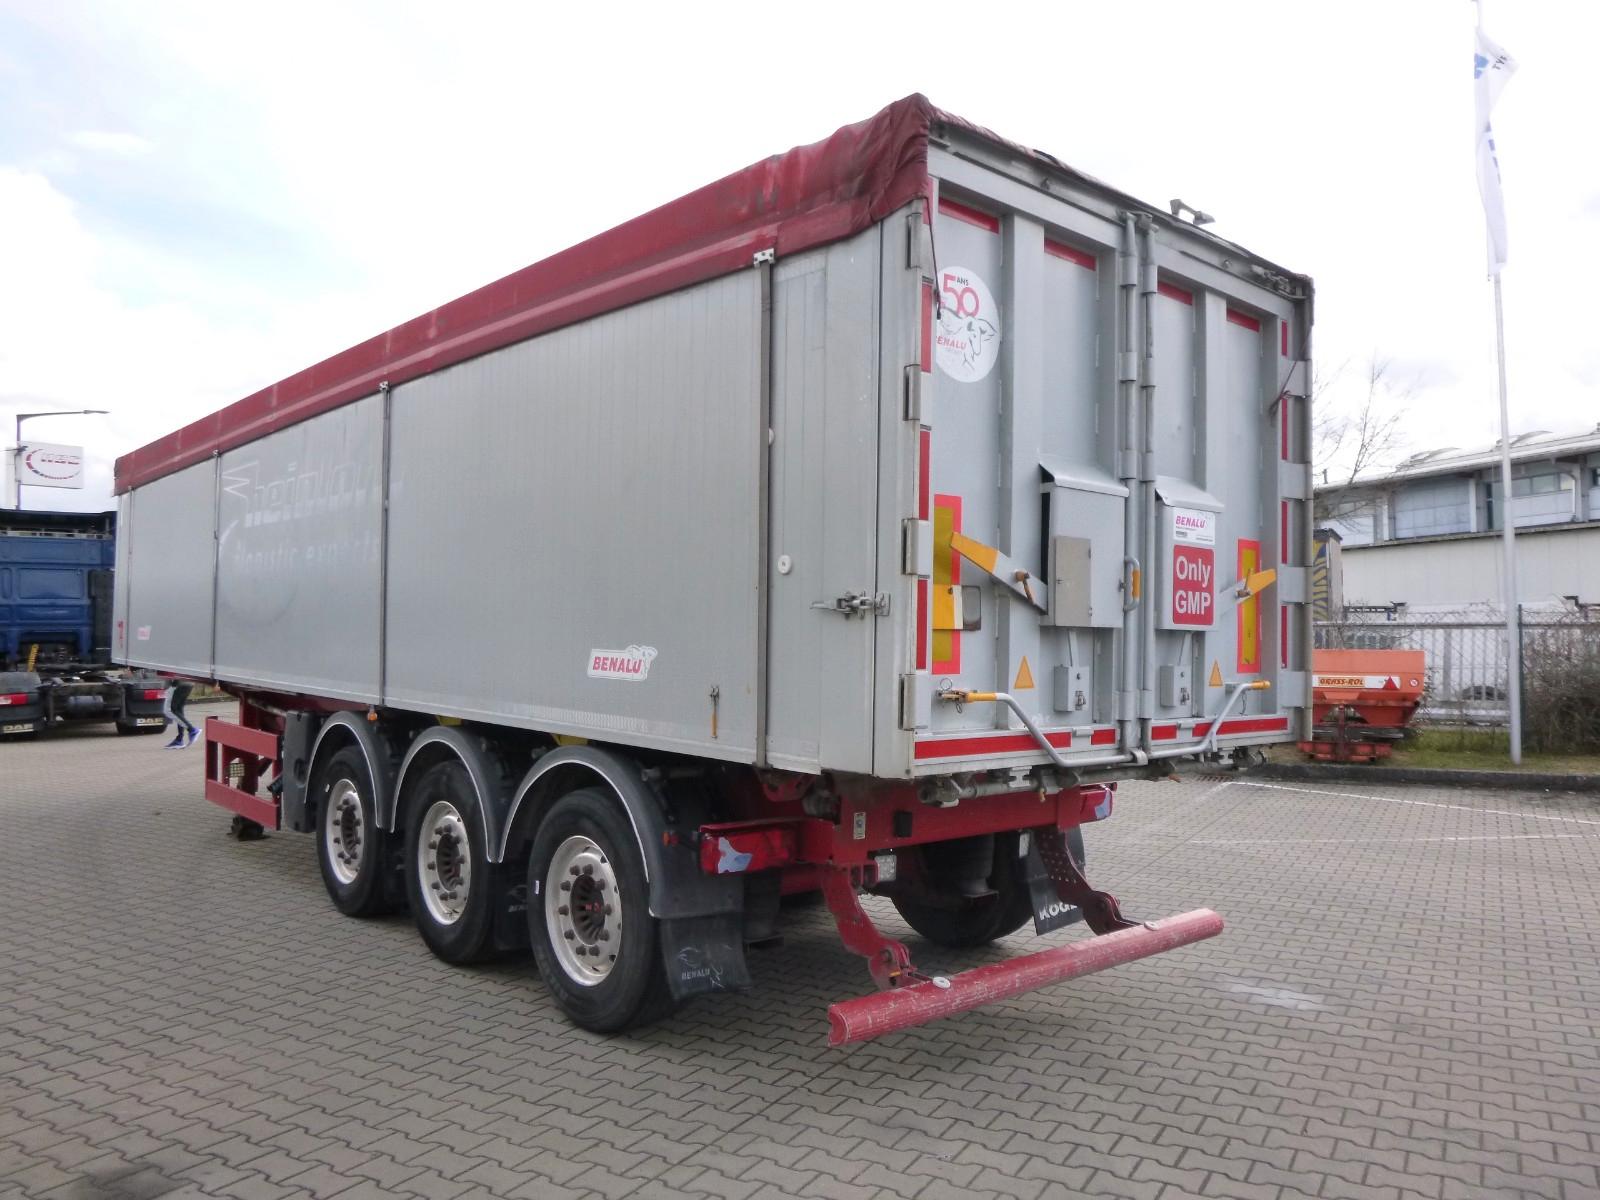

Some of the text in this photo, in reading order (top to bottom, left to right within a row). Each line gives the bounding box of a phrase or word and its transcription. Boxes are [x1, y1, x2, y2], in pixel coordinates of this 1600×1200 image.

[943, 272, 979, 318] 50
[935, 335, 967, 351] ENALU
[1175, 515, 1206, 529] BENALU
[1176, 555, 1211, 588] Only
[1175, 590, 1211, 615] GMP
[592, 656, 643, 674] BENALU
[3, 724, 34, 732] DAF
